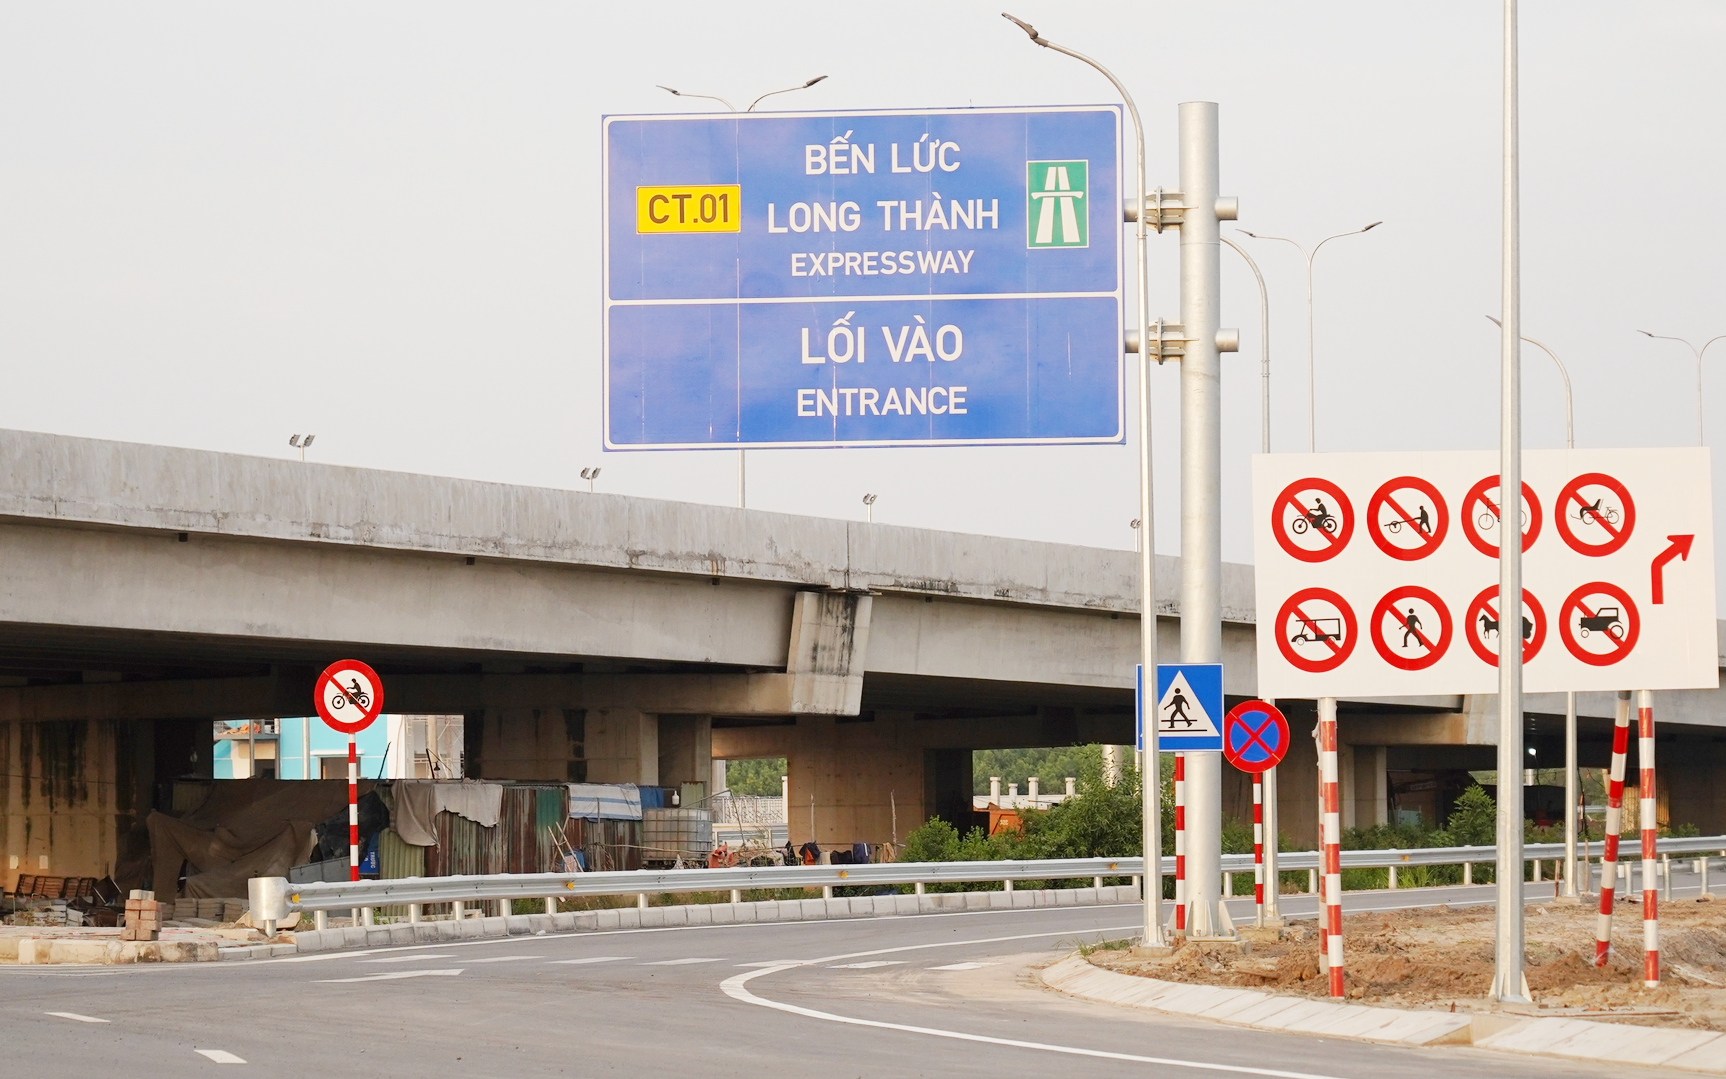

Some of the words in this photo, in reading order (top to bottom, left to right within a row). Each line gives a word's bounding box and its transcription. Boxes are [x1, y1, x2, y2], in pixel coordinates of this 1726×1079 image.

[805, 129, 875, 175] BẾN
[891, 133, 961, 173] LỨC
[648, 193, 729, 224] CT.01
[768, 201, 861, 233] LONG
[876, 191, 999, 231] THÀNH
[791, 250, 975, 277] EXPRESSWAY
[801, 311, 865, 364] LỐI
[881, 315, 963, 363] VÀO
[797, 386, 968, 417] ENTRANCE
